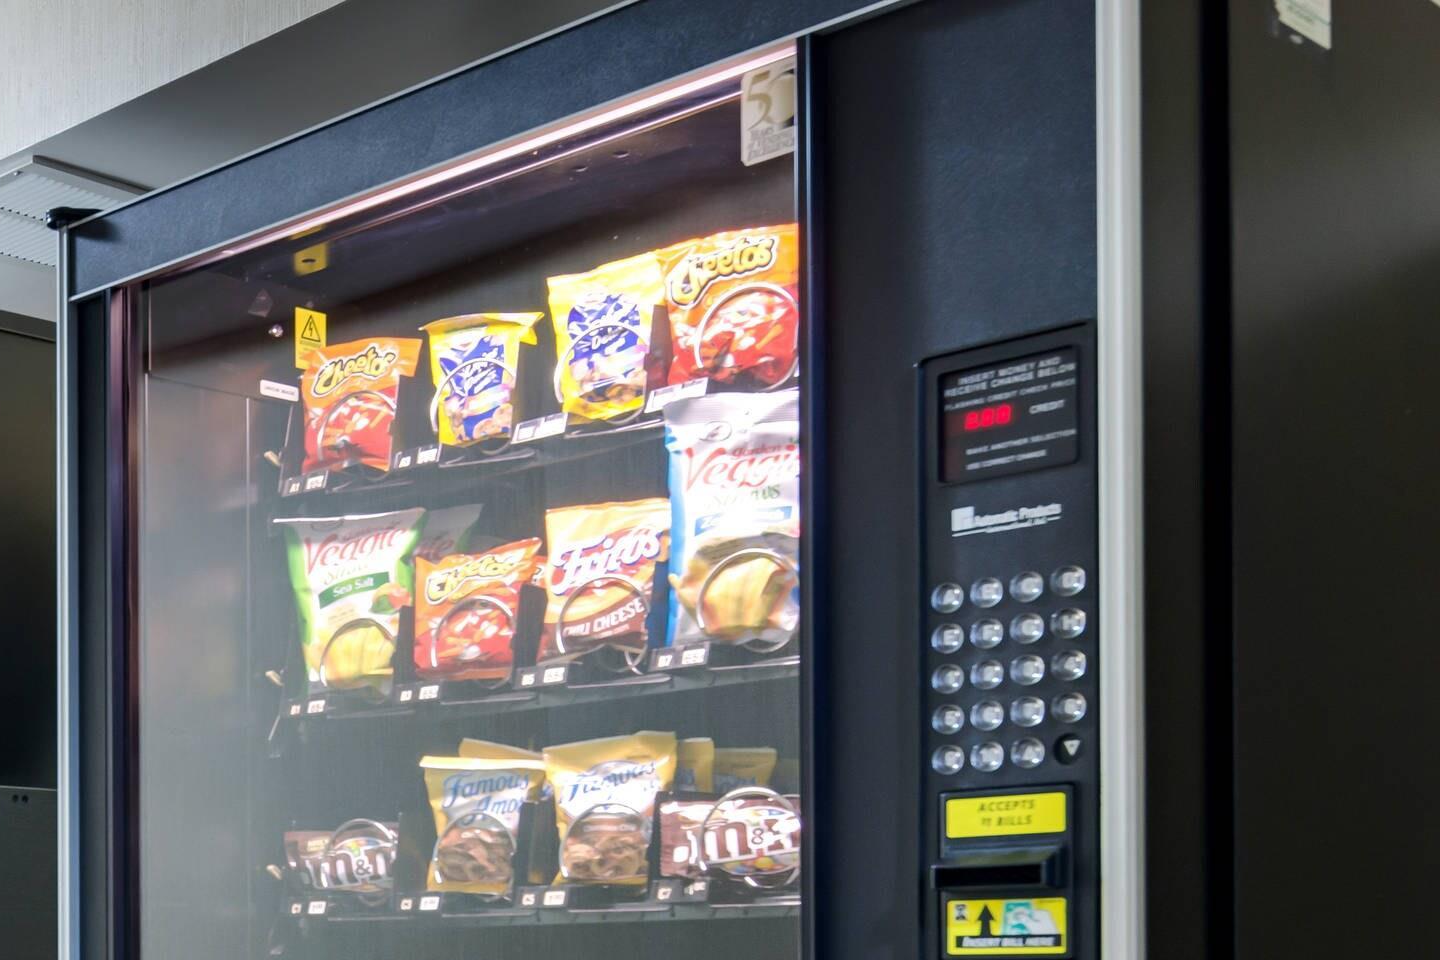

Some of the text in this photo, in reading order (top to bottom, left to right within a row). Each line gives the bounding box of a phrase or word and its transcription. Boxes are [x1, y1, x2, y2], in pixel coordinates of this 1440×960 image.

[671, 238, 774, 307] Cheetos
[314, 346, 396, 396] Cheetos
[990, 371, 1034, 387] CHANGE
[1037, 362, 1076, 378] BELOW
[998, 362, 1037, 377] MONEY
[1029, 399, 1065, 414] CREDIT
[304, 527, 407, 575] Veggie
[551, 526, 661, 596] Fritos
[333, 576, 374, 597] Sea Salt
[427, 555, 520, 603] Cheetos
[593, 599, 645, 632] CHEESE
[442, 772, 529, 809] Famous
[978, 799, 1036, 813] ACCEPTS
[996, 815, 1033, 827] BILLS
[962, 936, 1054, 948] INSERT BILL HERE
